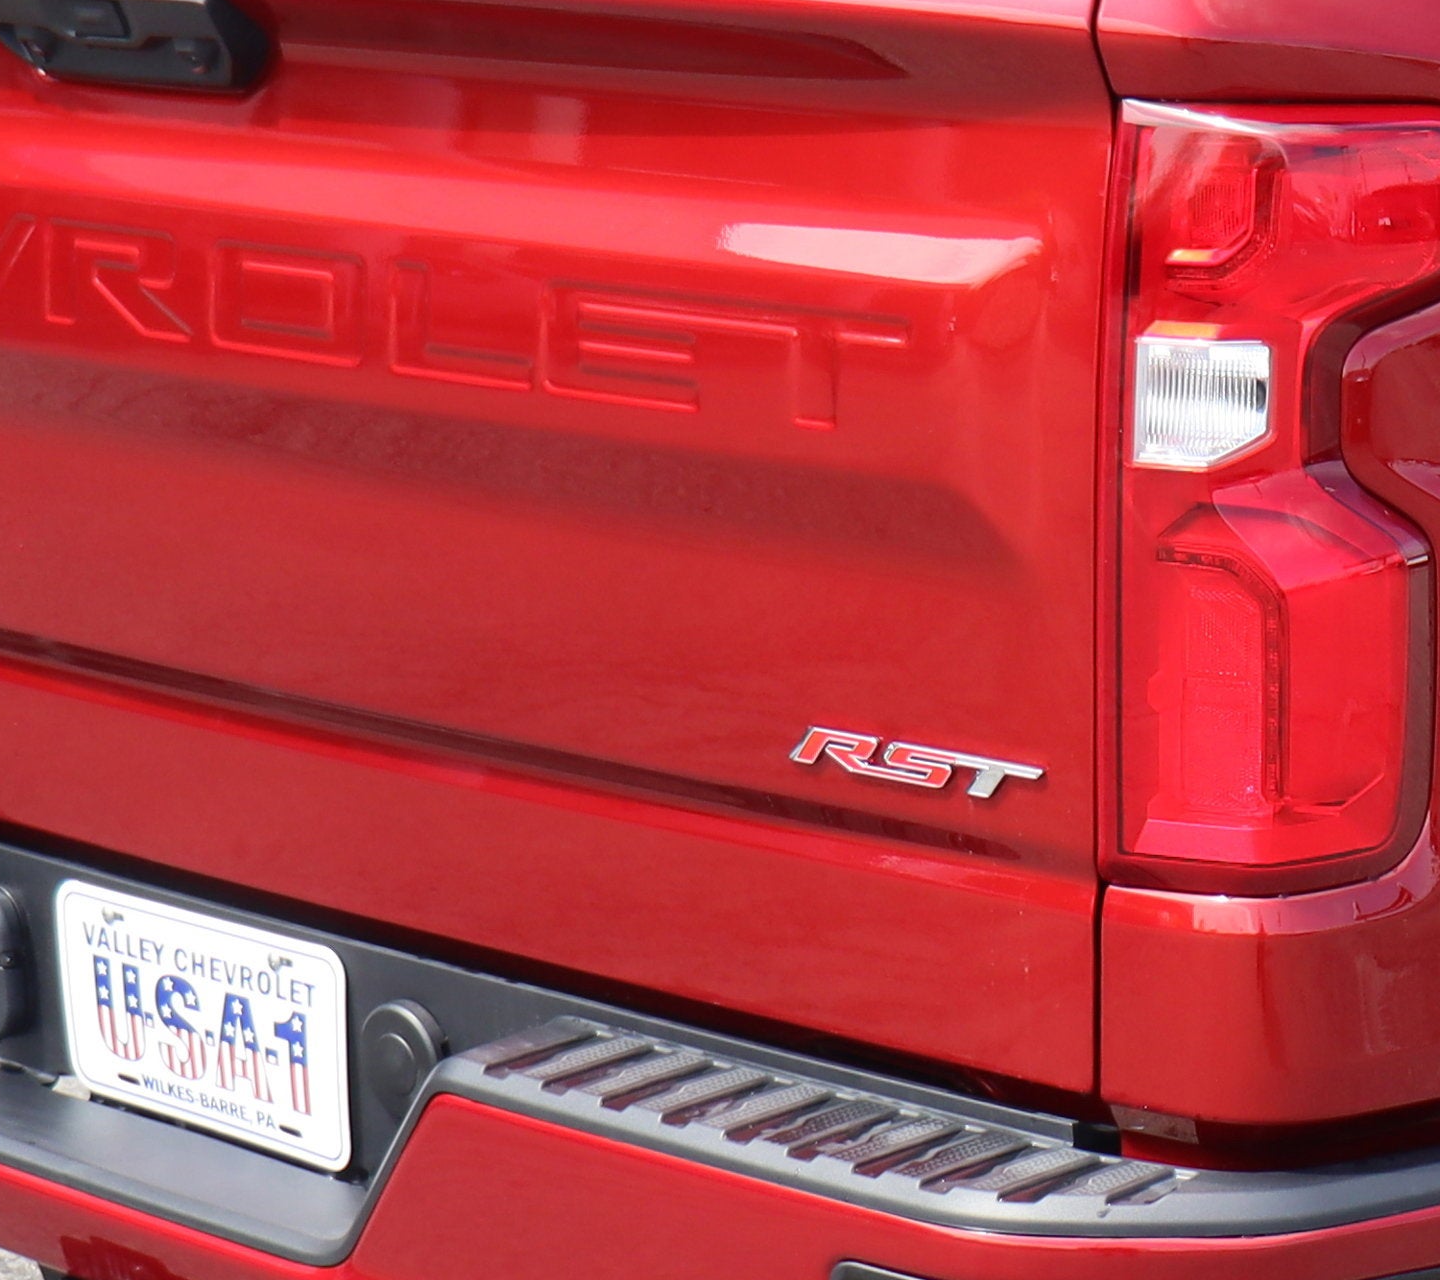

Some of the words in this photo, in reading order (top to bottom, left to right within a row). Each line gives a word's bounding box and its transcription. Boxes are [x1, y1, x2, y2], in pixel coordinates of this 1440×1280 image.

[789, 725, 1047, 798] RST
[83, 922, 164, 966] VALLEY
[174, 948, 317, 1008] CHEVROLET
[256, 1110, 277, 1130] PA
